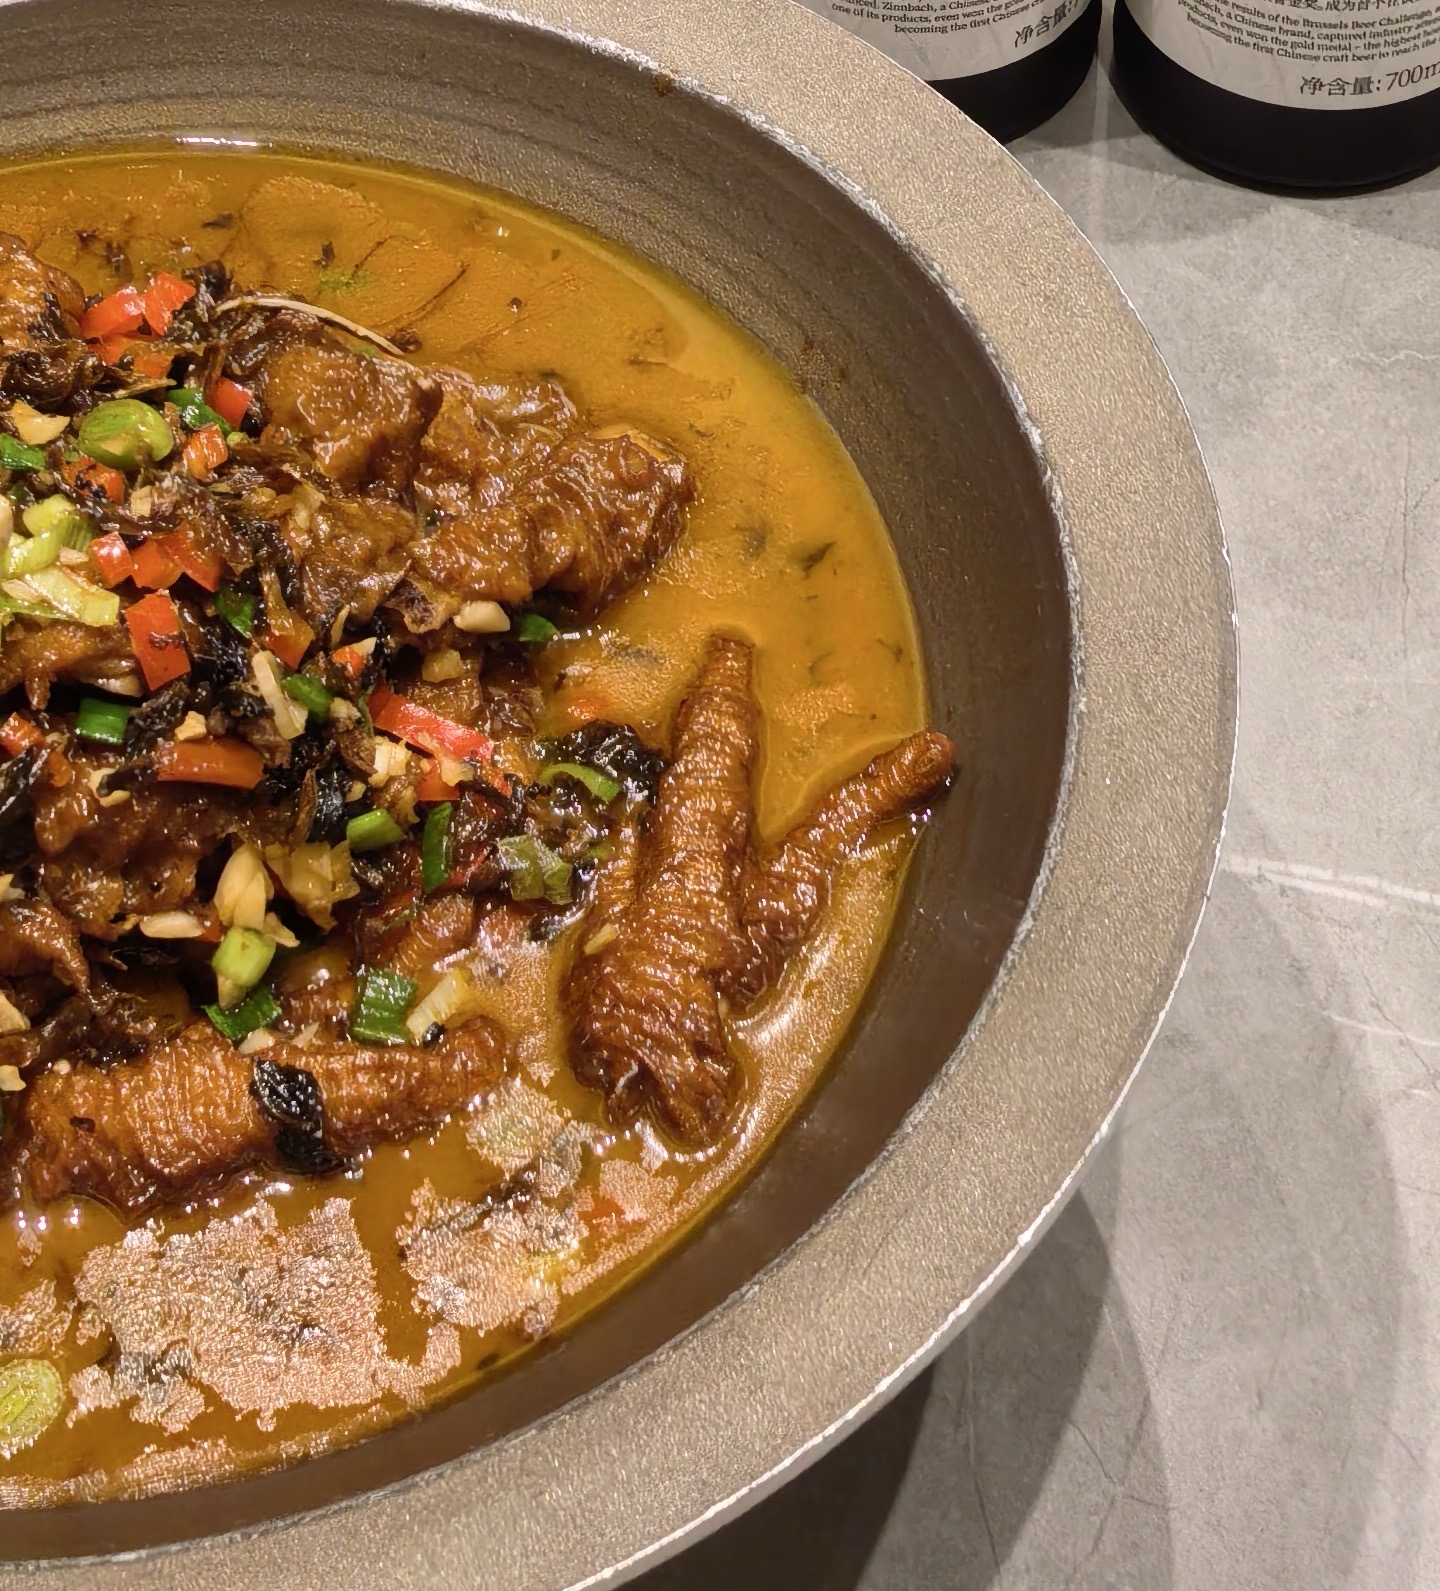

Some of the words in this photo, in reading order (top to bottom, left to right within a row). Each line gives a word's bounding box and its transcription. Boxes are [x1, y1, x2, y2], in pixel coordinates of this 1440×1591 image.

[831, 2, 852, 15] one
[866, 8, 880, 20] its
[881, 11, 932, 24] products,
[934, 11, 960, 23] even
[894, 23, 949, 35] becoming
[950, 21, 968, 32] the
[1268, 13, 1280, 22] of
[1282, 15, 1300, 27] the
[1302, 17, 1349, 29] Brussels
[1234, 37, 1251, 48] the
[1270, 36, 1289, 47] the
